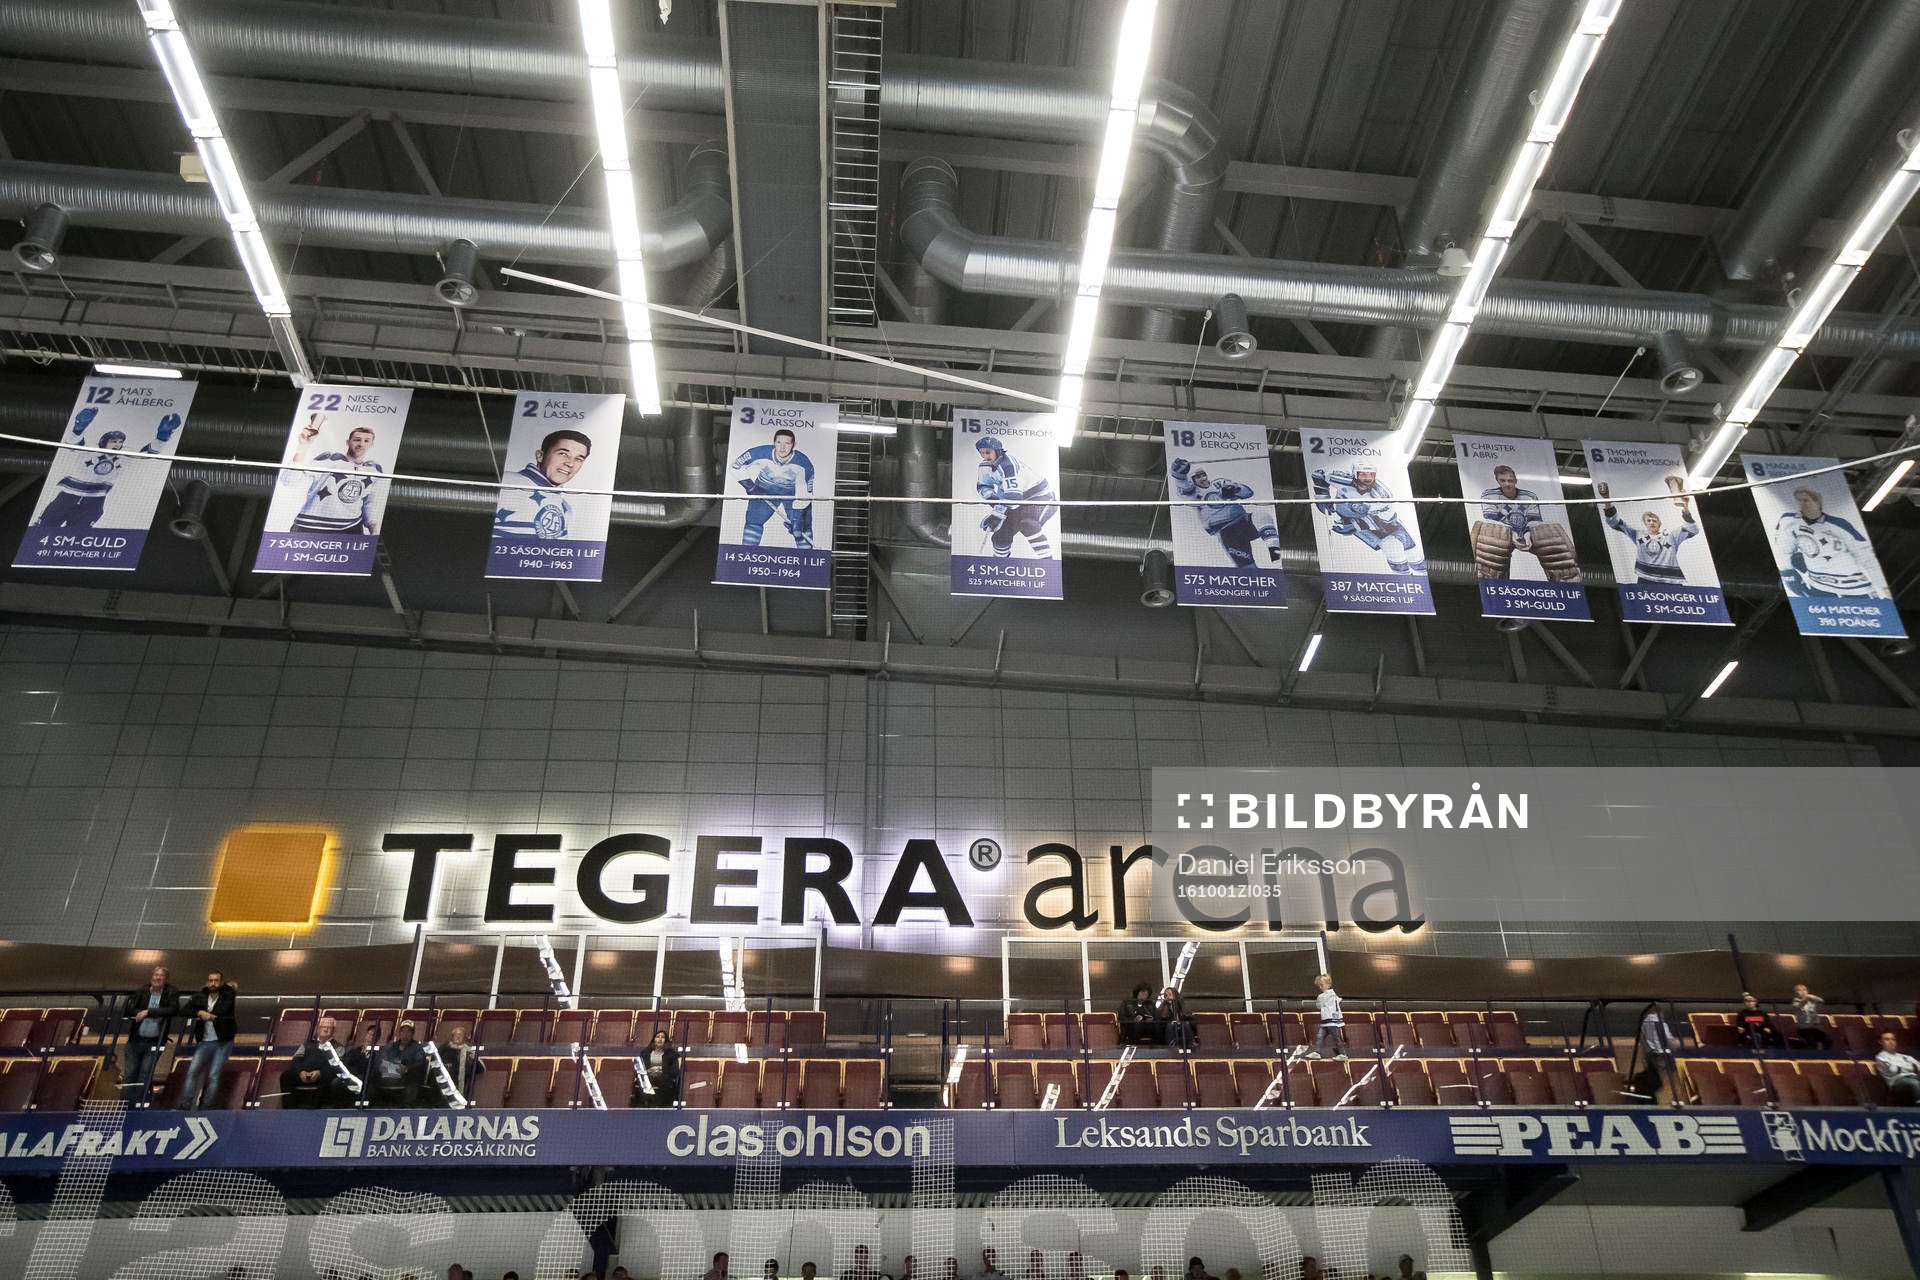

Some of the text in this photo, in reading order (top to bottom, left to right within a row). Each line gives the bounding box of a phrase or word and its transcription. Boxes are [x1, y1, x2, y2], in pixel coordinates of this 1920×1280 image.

[85, 386, 114, 404] 12
[119, 387, 153, 396] MATS
[307, 394, 342, 411] 22
[347, 395, 381, 403] NISSE
[344, 405, 398, 414] NILSSON
[522, 400, 539, 417] 2
[761, 408, 804, 418] VILGOT
[543, 411, 585, 420] LASSAS
[740, 407, 755, 424] 3
[760, 418, 815, 428] LARSSON
[960, 418, 981, 433] 15
[985, 419, 1009, 427] DAN
[1171, 430, 1195, 447] 18
[1199, 430, 1236, 440] JONAS
[1200, 440, 1262, 451] BERGQVIST
[1309, 437, 1324, 454] 2
[1328, 437, 1368, 447] TOMAS
[1471, 443, 1516, 451] CHRISTER
[1328, 447, 1382, 457] JONSSON
[1460, 442, 1469, 457] 1
[1472, 451, 1499, 459] ABRIS
[1590, 448, 1604, 463] 6
[1607, 457, 1680, 466] ABRAHAMSSON
[1751, 462, 1765, 476] 8
[1005, 478, 1018, 489] 15
[40, 536, 127, 548] 4 SM-GULD
[269, 540, 277, 548] 7
[353, 542, 370, 551] LIF
[54, 550, 100, 558] MATCHER
[108, 551, 122, 559] LIF
[293, 553, 349, 563] SM-GULD
[495, 546, 508, 555] 23
[584, 549, 600, 558] LIF
[725, 552, 735, 561] 14
[810, 557, 826, 567] LIF
[967, 564, 1046, 578] 4 SM-GULD
[968, 578, 982, 586] 525
[984, 579, 1026, 587] MATCHER
[1184, 574, 1277, 588] 575 MATCHER
[1194, 588, 1202, 596] 15
[1330, 581, 1425, 594] 387 MATCHER
[1486, 586, 1496, 595] 15
[1566, 590, 1581, 599] LIF
[1625, 592, 1635, 600] 13
[1705, 595, 1719, 604] LIF
[1505, 600, 1566, 611] 3 SM-GULD
[1645, 604, 1706, 615] 3 SM-GULD
[1828, 605, 1882, 616] MATCHER
[1023, 842, 1427, 935] arena
[370, 1115, 540, 1142] DALARNAS
[666, 1115, 931, 1158] clas ohlson
[1054, 1116, 1373, 1156] Leksands Sparbank
[1497, 1115, 1708, 1156] PEAB
[366, 1141, 537, 1157] BANK & FÖRSÄKRING
